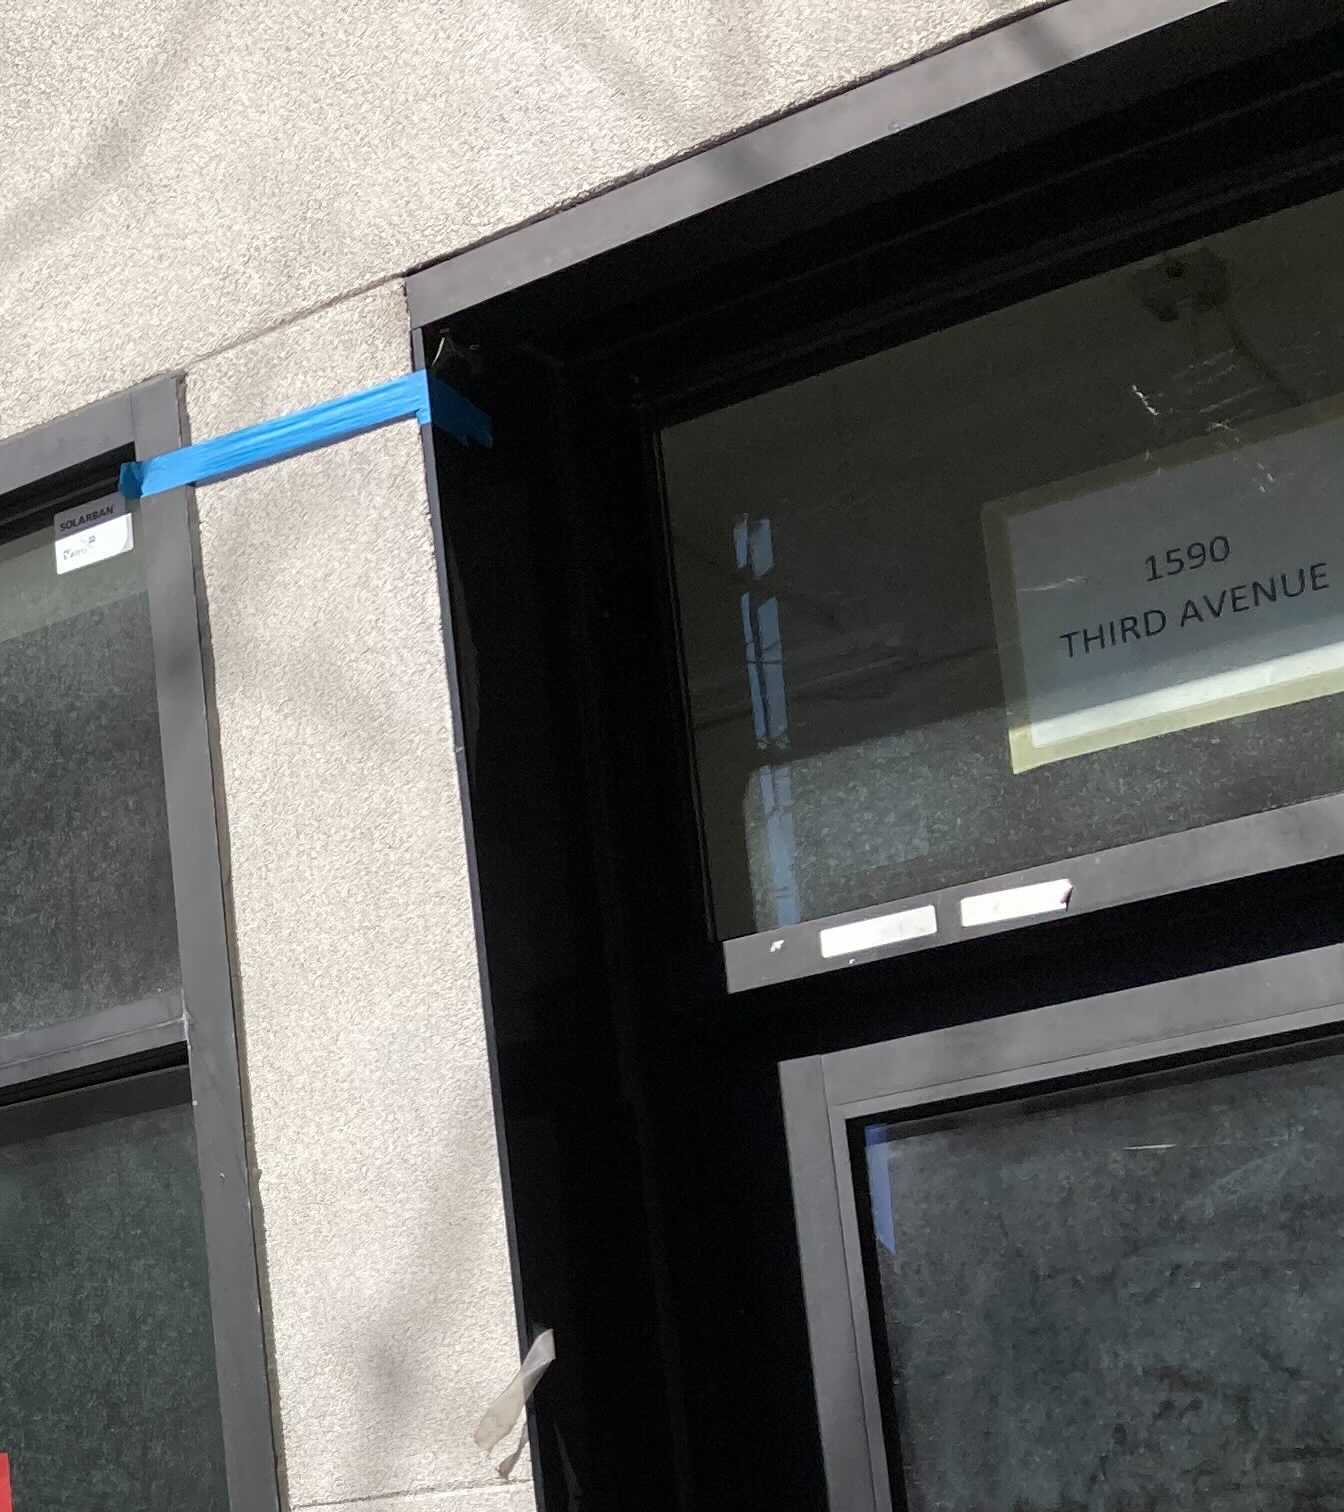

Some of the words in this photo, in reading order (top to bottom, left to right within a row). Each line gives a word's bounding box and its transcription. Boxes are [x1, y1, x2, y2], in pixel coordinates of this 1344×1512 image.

[60, 506, 114, 531] SOLARBAN
[1144, 535, 1231, 582] 1590
[1060, 608, 1167, 660] THIRD
[1179, 562, 1330, 628] AVENUE
